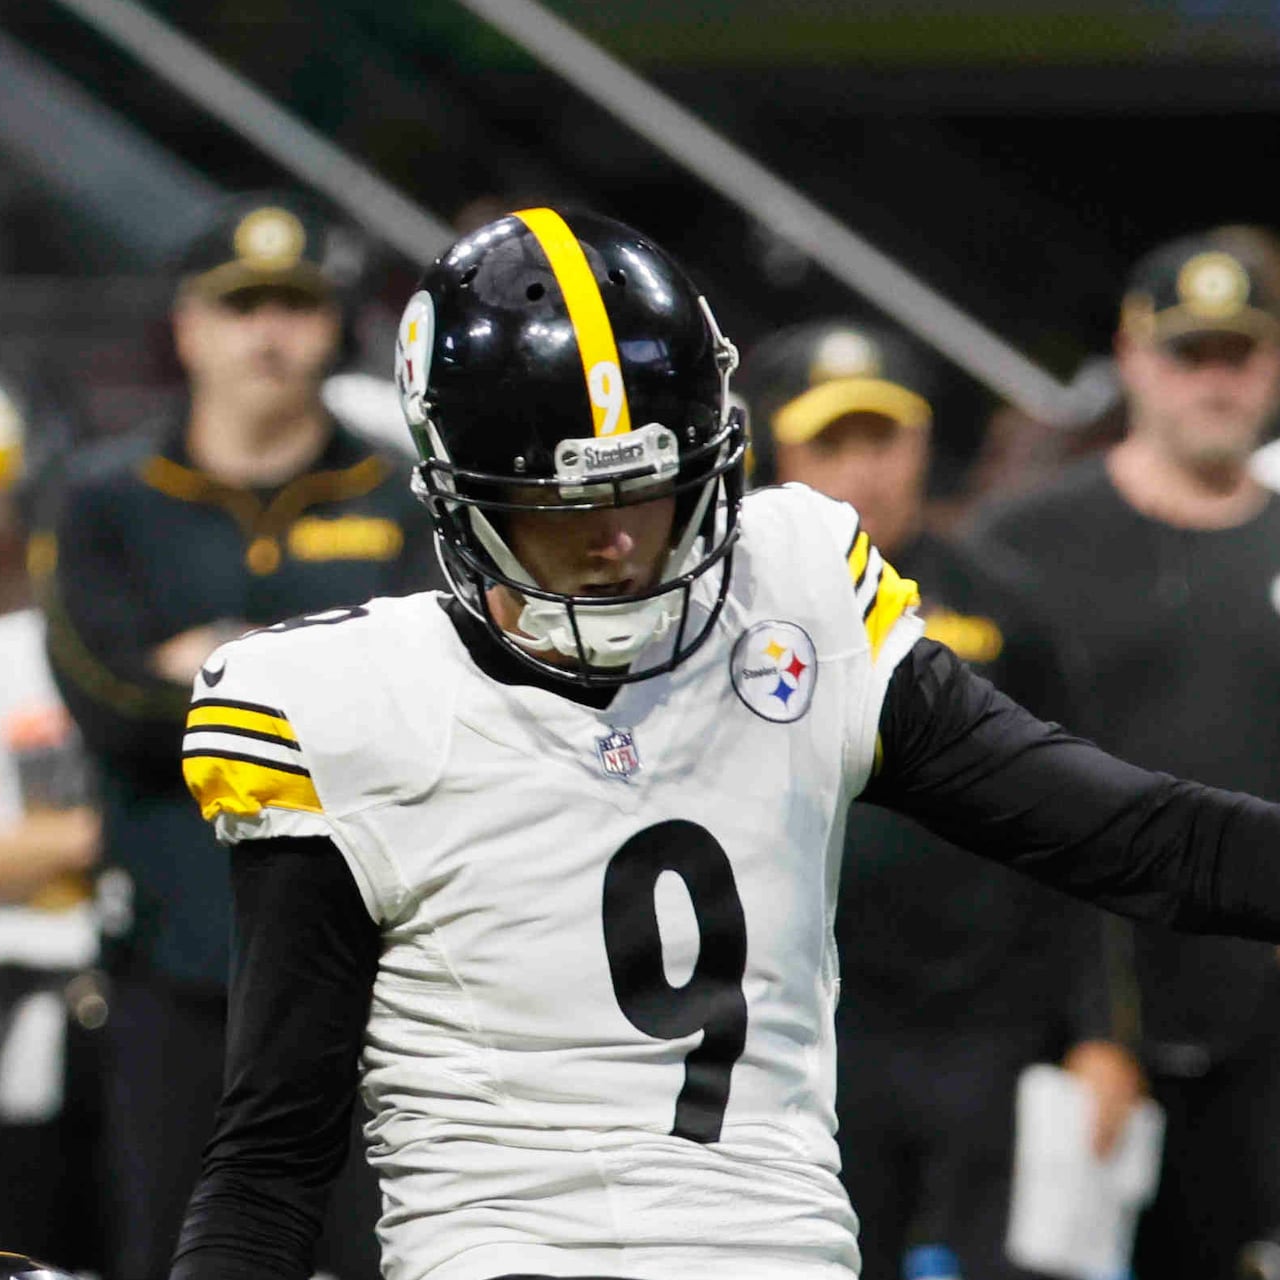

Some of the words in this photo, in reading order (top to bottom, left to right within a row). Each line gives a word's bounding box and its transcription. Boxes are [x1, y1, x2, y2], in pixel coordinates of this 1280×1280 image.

[589, 361, 625, 434] 9
[584, 442, 644, 470] Steelers
[602, 818, 749, 1144] 9
